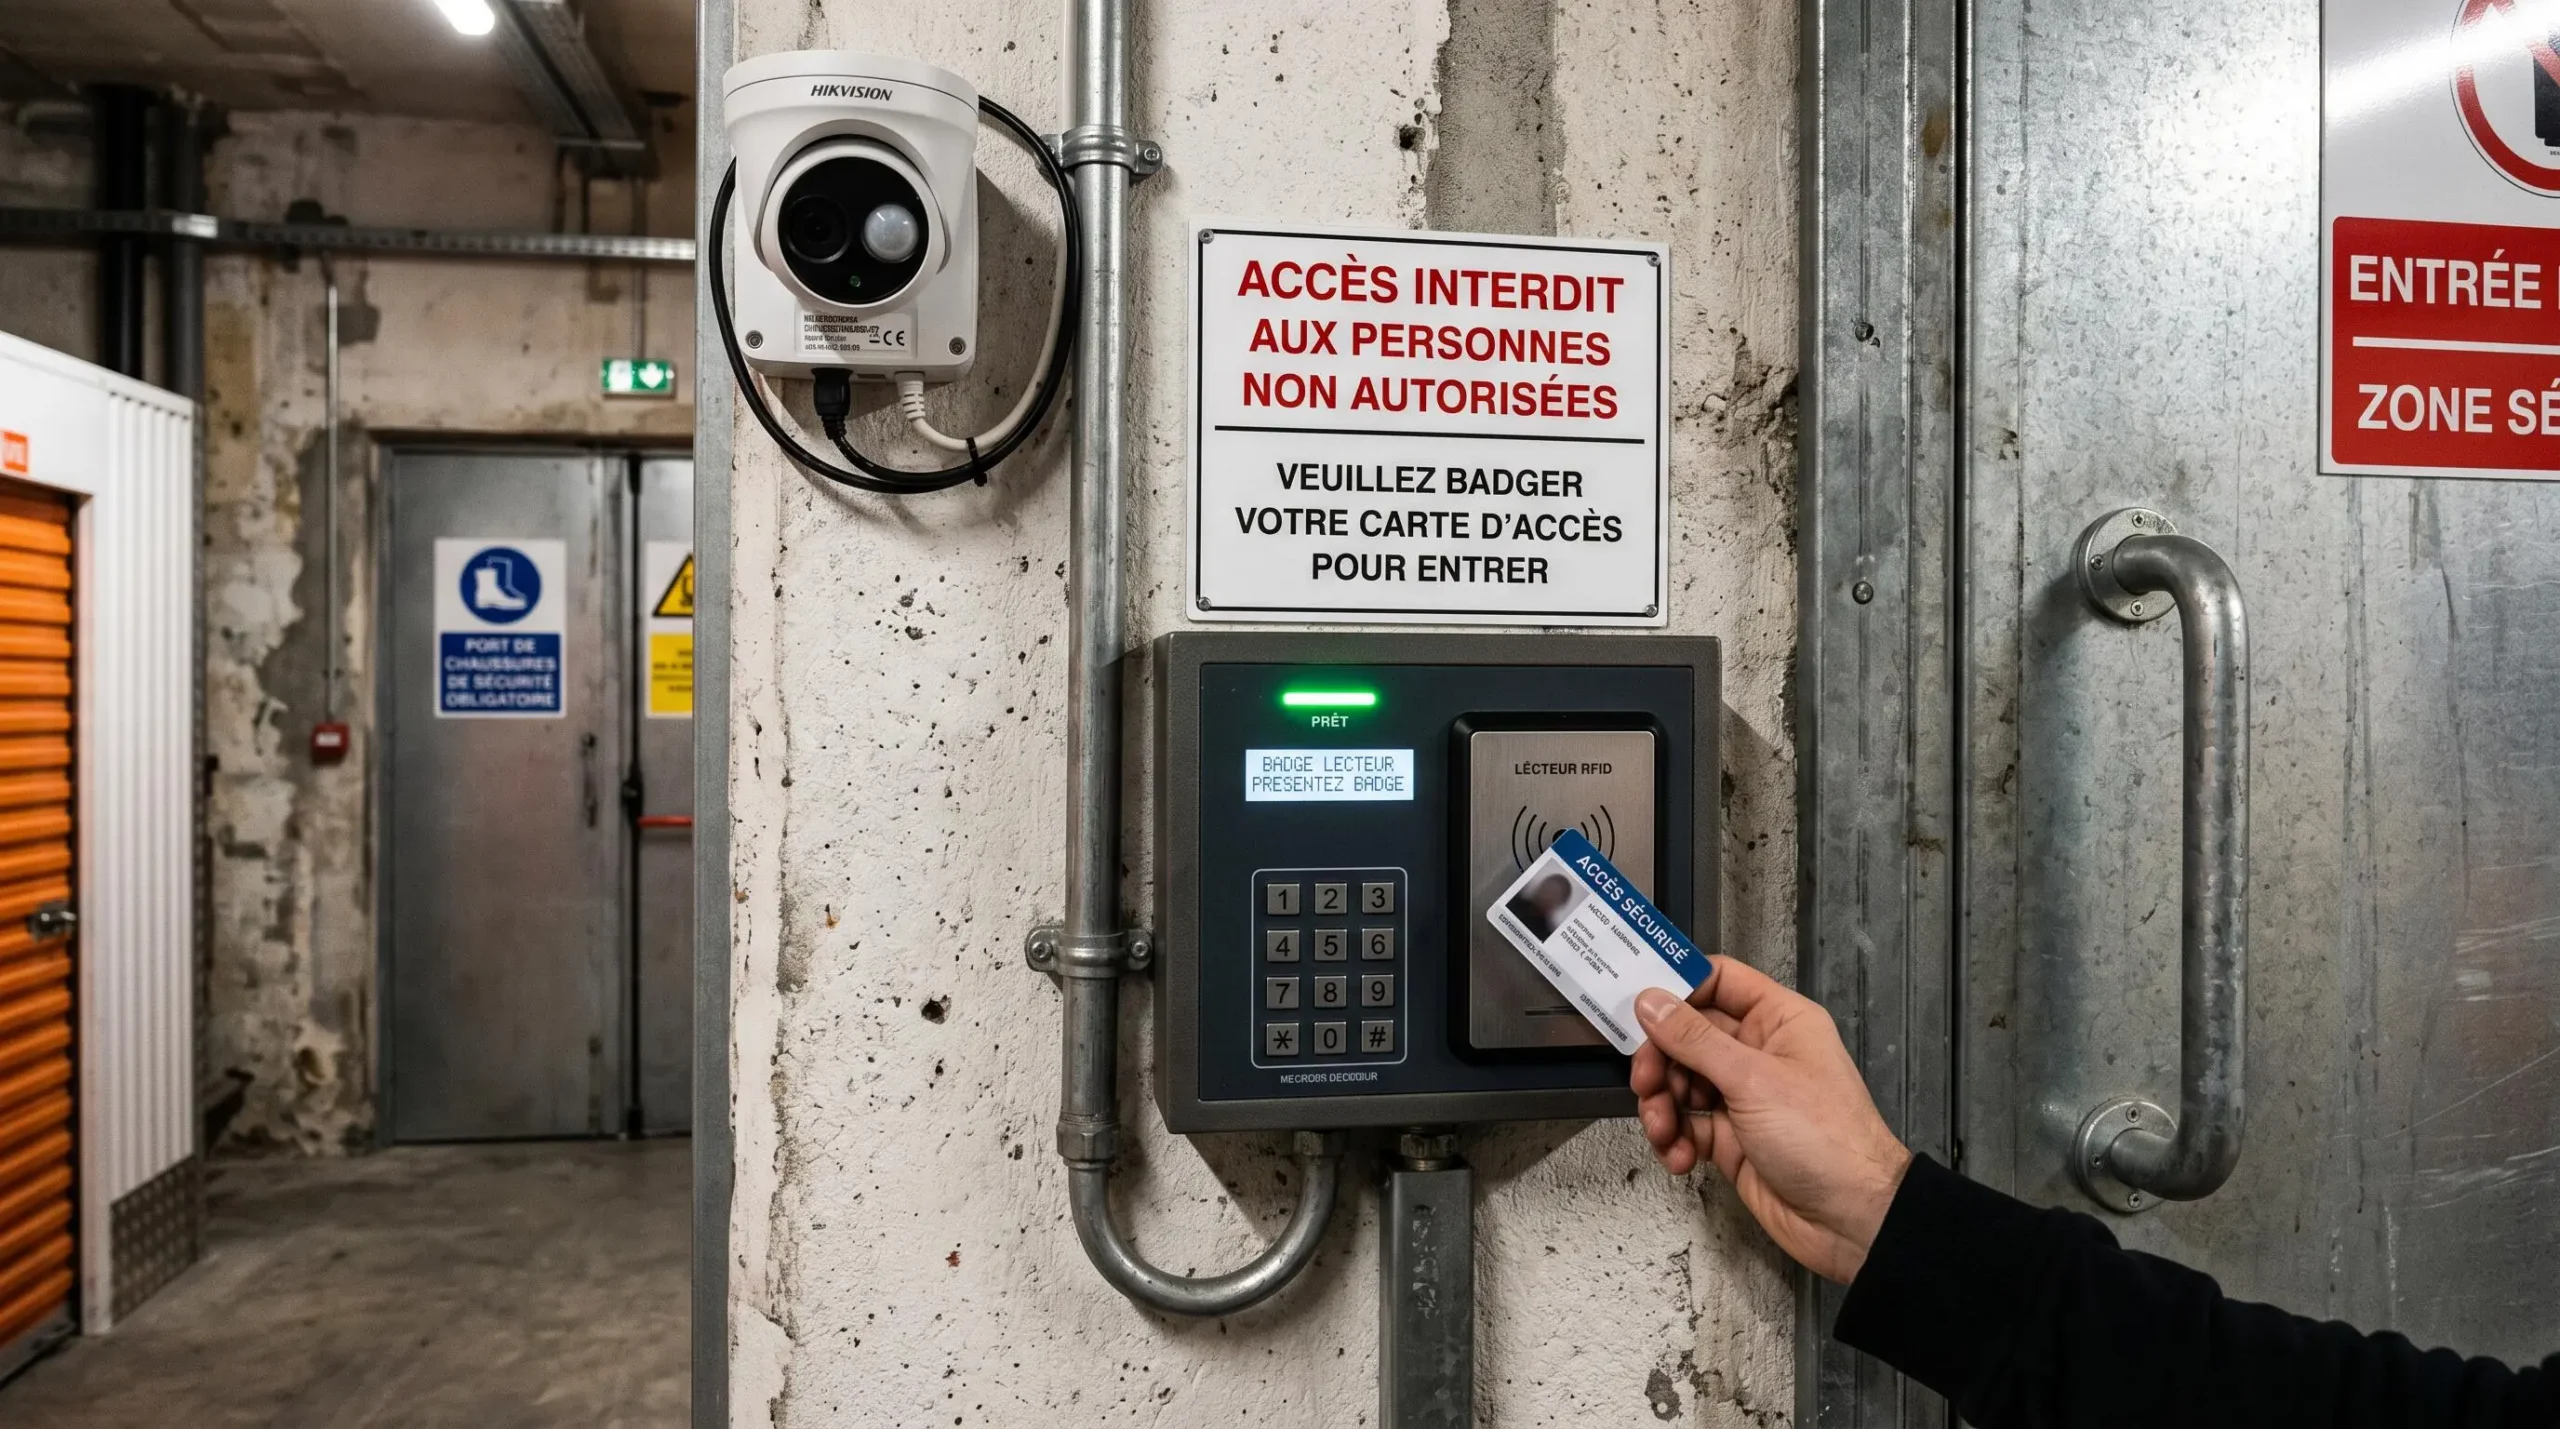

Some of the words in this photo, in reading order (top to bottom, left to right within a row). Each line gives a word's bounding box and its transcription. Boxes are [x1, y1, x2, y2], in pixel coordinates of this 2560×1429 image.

[811, 84, 893, 101] HIKVISION
[1237, 253, 1399, 304] ACCÈS
[1414, 267, 1624, 314] INTERDIT
[2350, 248, 2542, 309] ENTRÉE
[1249, 318, 1337, 356] AUX
[1351, 321, 1611, 367] PERSONNES
[1243, 371, 1337, 410] NON
[1350, 374, 1619, 420] AUTORISÉES
[2357, 383, 2493, 434] ZONE
[1276, 462, 1436, 494] VEUILLEZ
[1446, 467, 1583, 498] BADGER
[1234, 506, 1349, 536] VOTRE
[1359, 509, 1470, 539] CARTE
[1312, 552, 1406, 582] POUR
[1418, 554, 1548, 584] ENTRER
[464, 637, 509, 653] PORT
[513, 637, 537, 653] DE
[444, 655, 557, 671] CHAUSSURES
[446, 674, 468, 690] DE
[1311, 712, 1349, 728] PRÊT
[1262, 756, 1313, 772] BADGE
[1324, 756, 1394, 772] LECTEUR
[1581, 762, 1612, 775] RFID
[1252, 776, 1344, 792] PRESENTEZ
[1354, 776, 1404, 792] BADGE
[1278, 888, 1287, 910] 1
[1323, 887, 1338, 910] 2
[1371, 887, 1386, 909] 3
[1620, 898, 1690, 965] SÉCURISÉ
[1275, 935, 1291, 957] 4
[1323, 934, 1339, 957] 5
[1371, 933, 1386, 955] 6
[1275, 982, 1291, 1004] 7
[1323, 981, 1338, 1003] 8
[1371, 980, 1386, 1002] 9
[1323, 1027, 1338, 1049] 0
[1369, 1025, 1386, 1048] #
